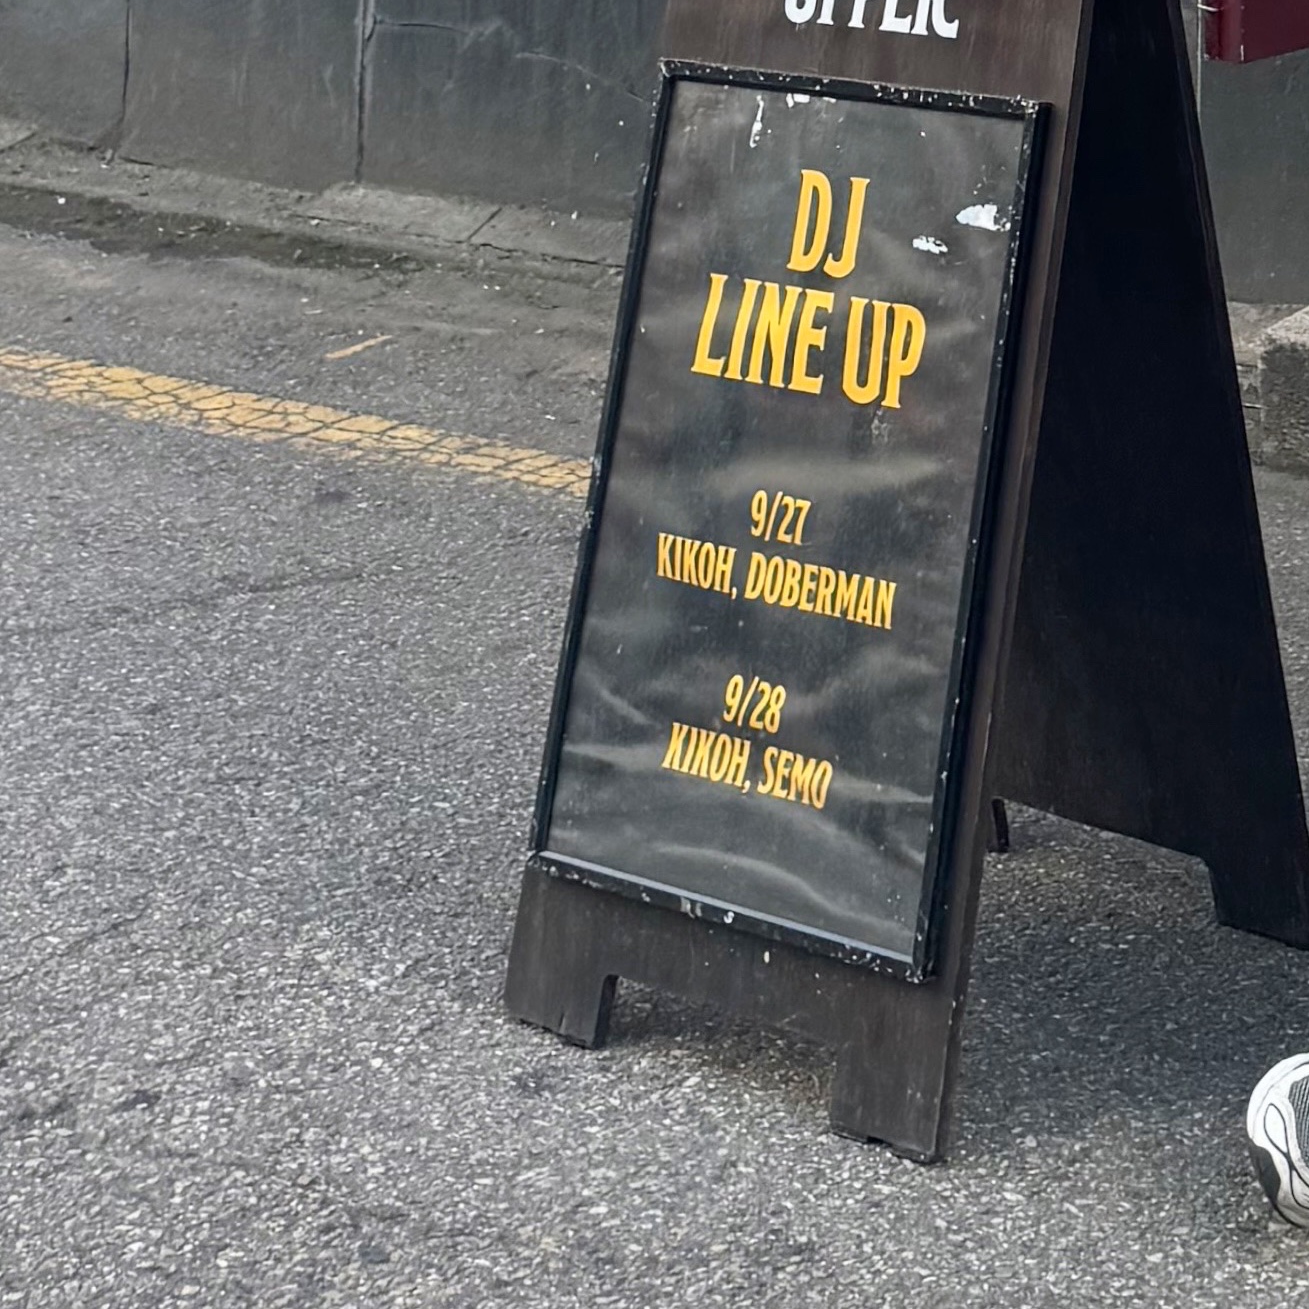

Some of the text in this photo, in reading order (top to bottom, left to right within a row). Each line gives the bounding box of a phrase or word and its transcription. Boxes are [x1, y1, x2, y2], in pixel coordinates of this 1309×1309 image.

[786, 168, 870, 279] DJ
[691, 272, 927, 409] LINE UP
[750, 489, 812, 545] 9/27
[656, 532, 897, 630] KIKOH, DOBERMAN
[722, 674, 786, 734] 9/28
[661, 722, 833, 810] KIKOH, SEMO
